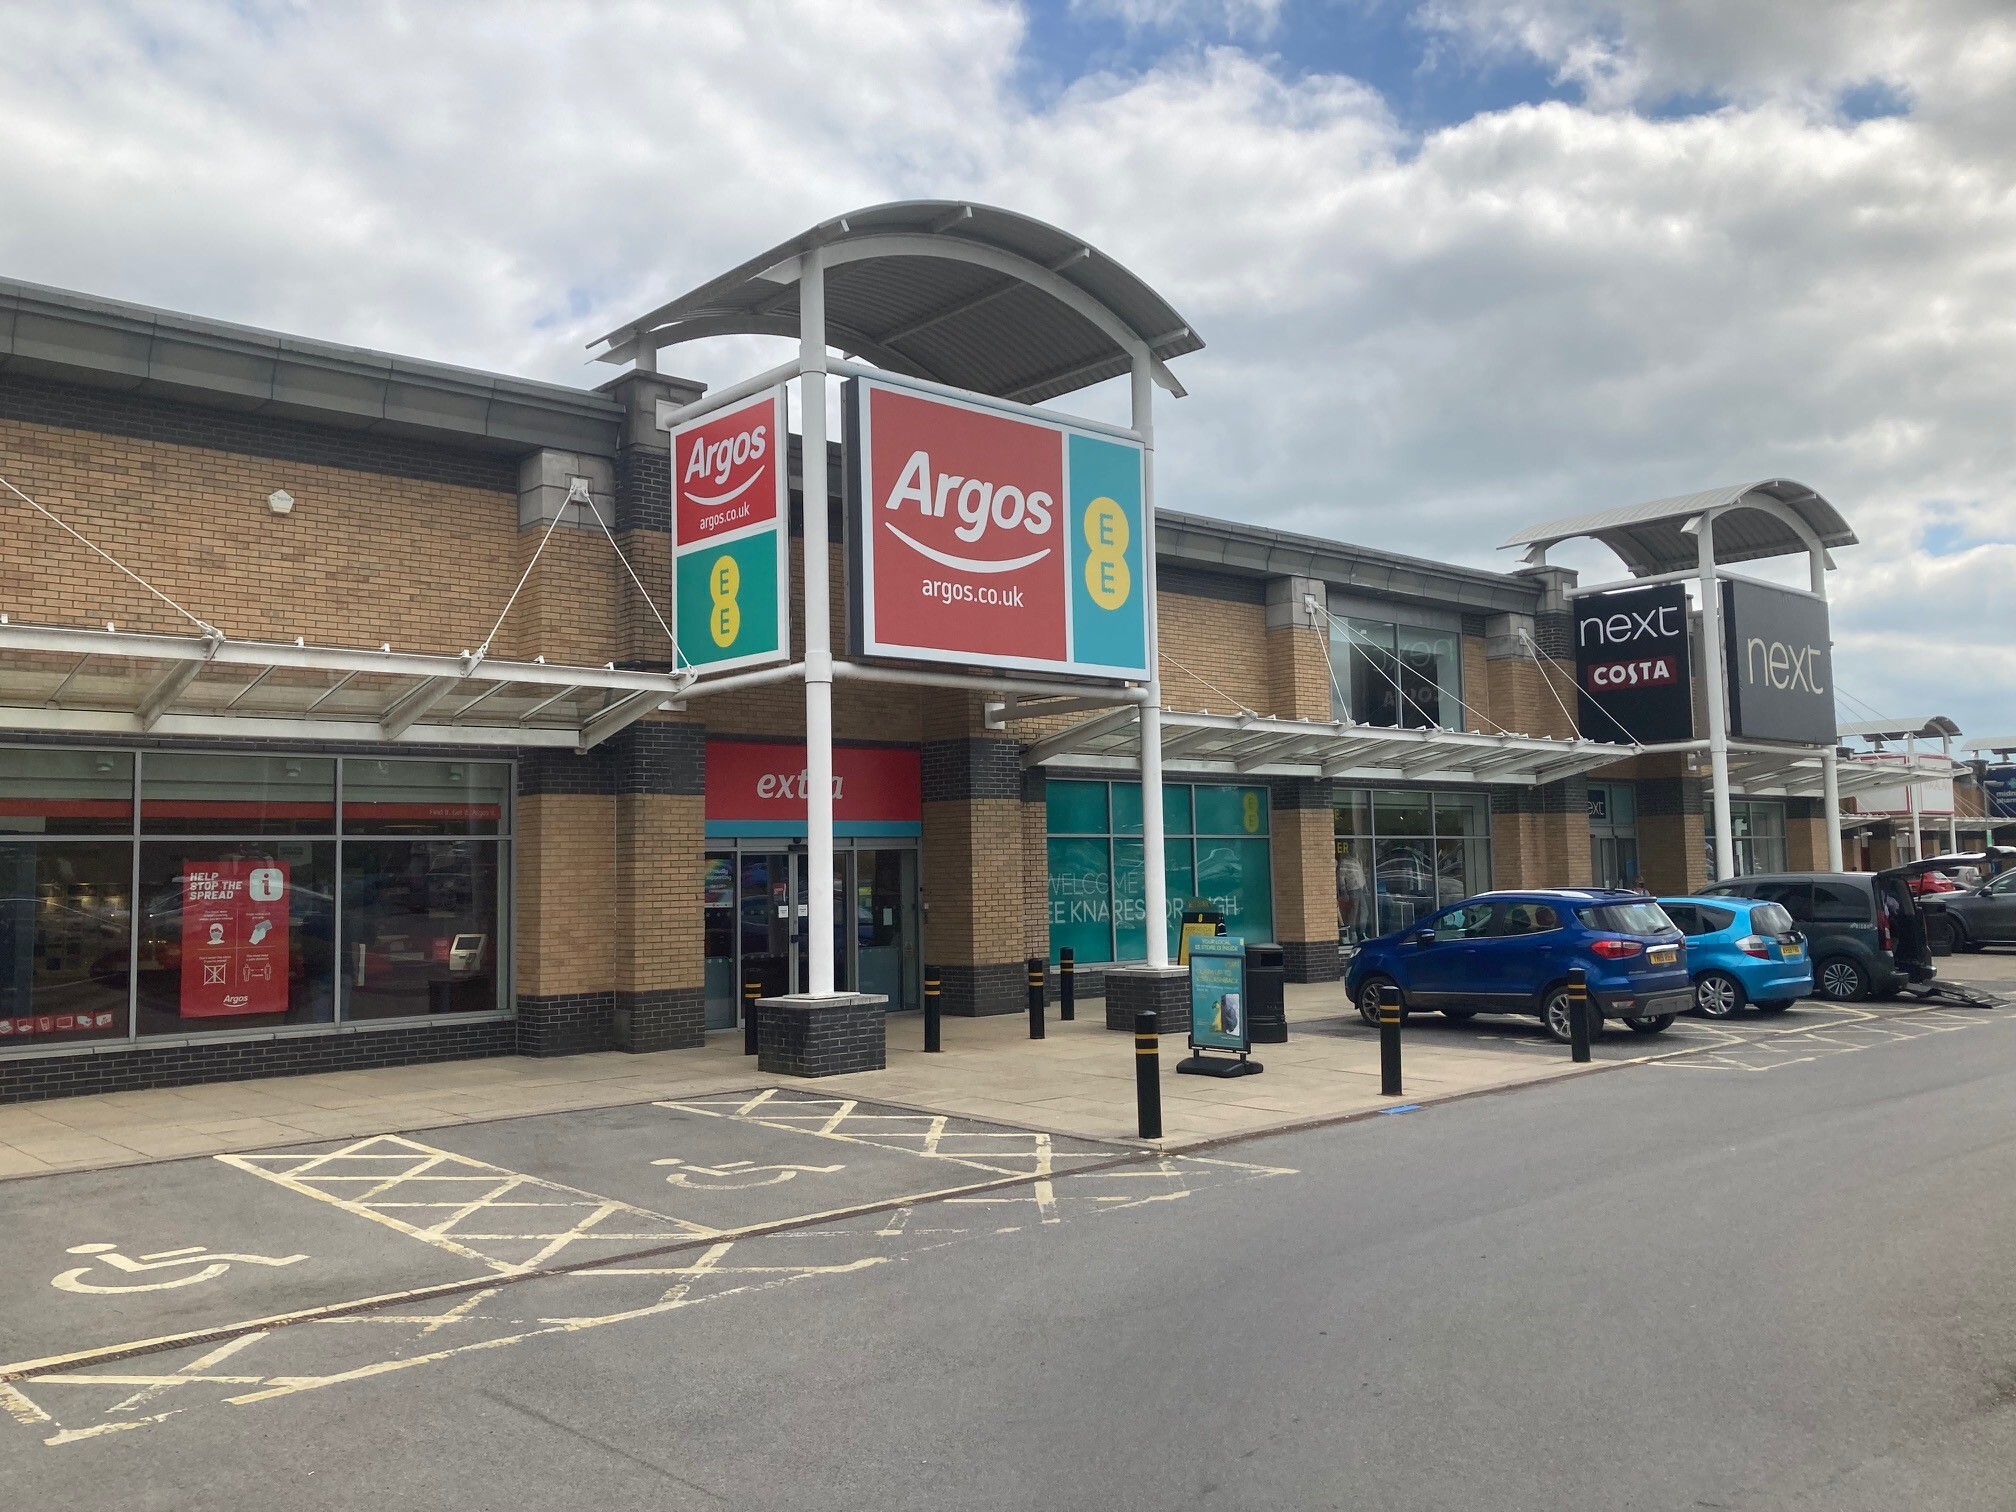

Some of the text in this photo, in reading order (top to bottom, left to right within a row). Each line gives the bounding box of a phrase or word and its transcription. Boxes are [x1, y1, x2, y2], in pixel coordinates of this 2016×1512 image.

[685, 424, 767, 485] Argos
[885, 449, 1054, 543] Argos
[699, 501, 751, 531] argos.co.uk
[921, 577, 1025, 609] argos.co.uk
[1580, 605, 1680, 647] next
[1593, 660, 1670, 685] COSTA
[1747, 637, 1825, 696] next
[756, 768, 844, 800] exta
[1588, 800, 1605, 816] ext
[190, 872, 219, 881] HELP
[190, 881, 243, 891] STOP THE
[1048, 871, 1138, 895] WELCOME
[190, 890, 234, 900] SPREAD
[223, 994, 248, 1005] Argos
